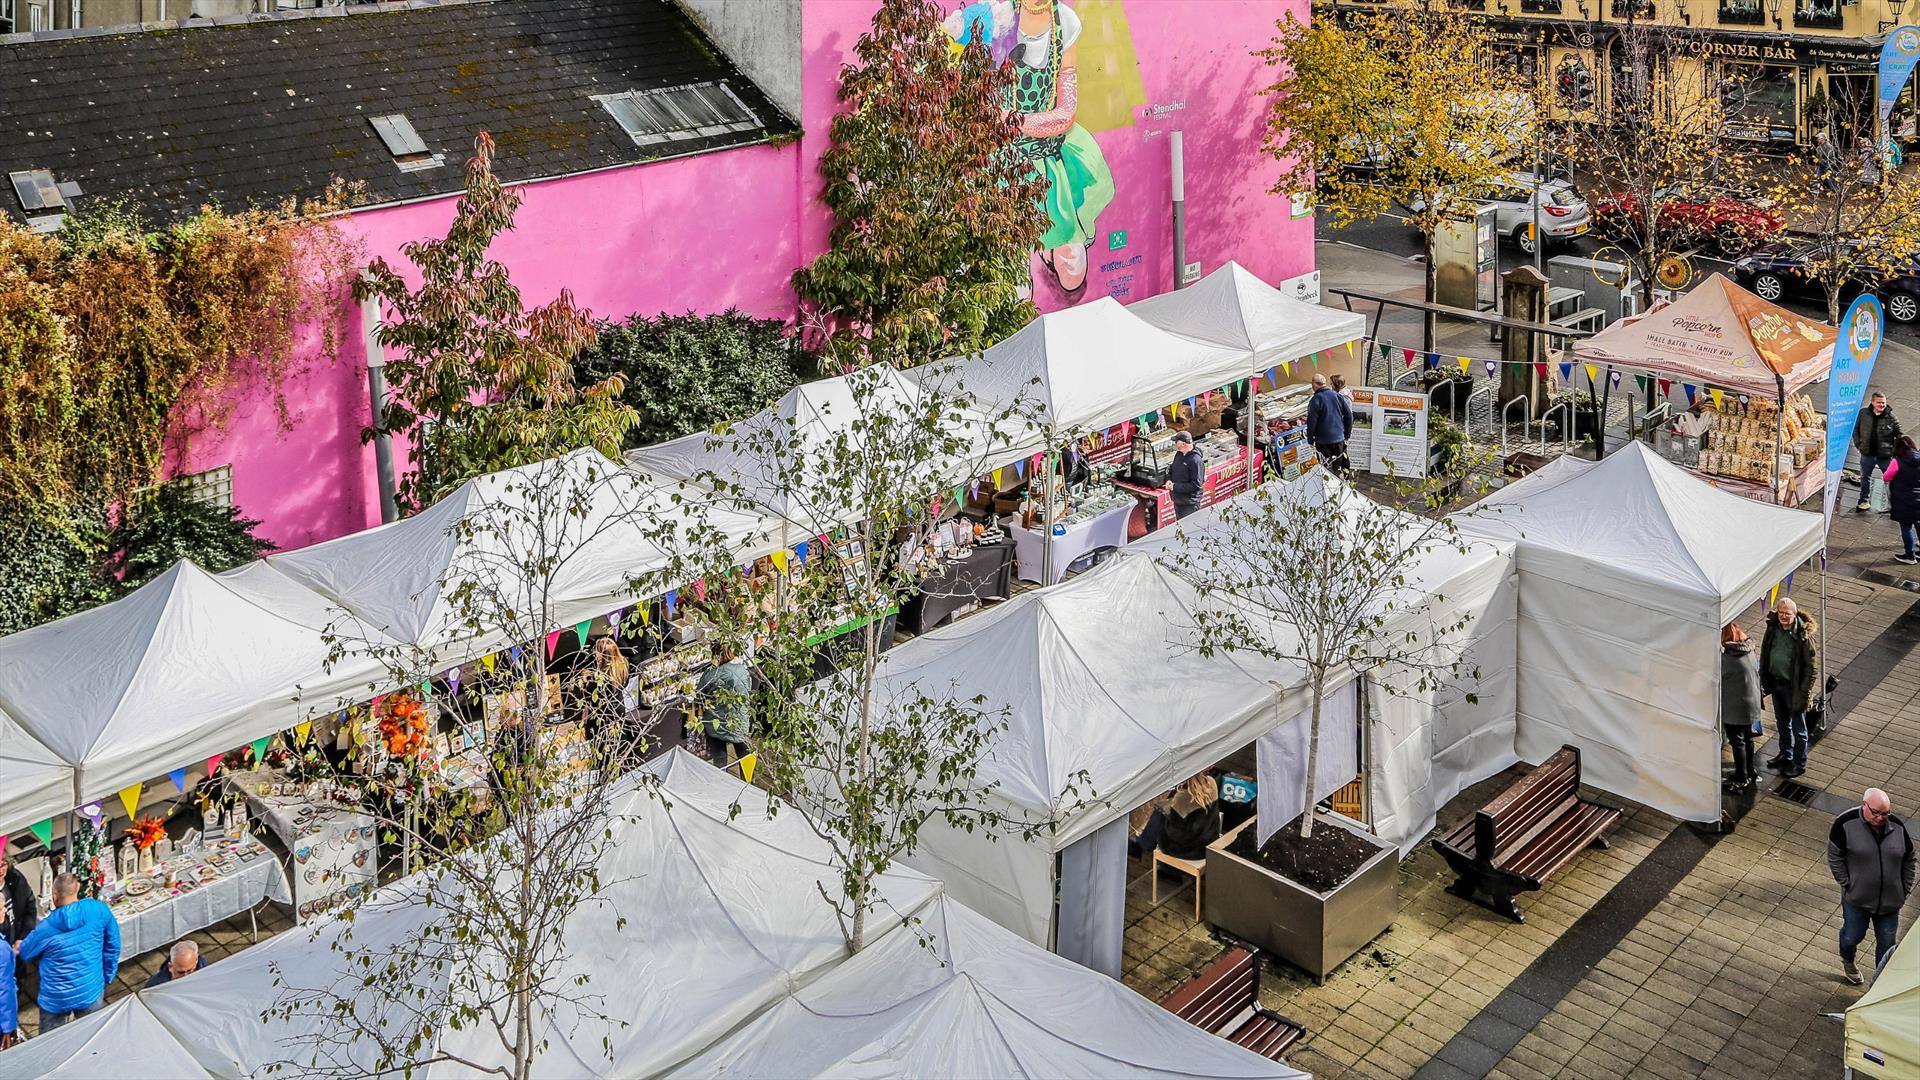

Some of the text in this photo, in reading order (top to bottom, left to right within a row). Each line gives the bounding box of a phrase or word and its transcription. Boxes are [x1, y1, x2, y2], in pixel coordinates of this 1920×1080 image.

[1690, 42, 1759, 57] CORNER
[1763, 46, 1797, 60] BAR
[1153, 97, 1186, 115] Stendhal
[1672, 317, 1722, 333] Popcorn
[1646, 334, 1665, 344] SMALL
[1667, 340, 1688, 348] BATCH
[1695, 344, 1718, 354] FAMILY
[1836, 358, 1851, 369] ART
[1383, 395, 1400, 403] TULLY
[1839, 384, 1862, 398] CRAFT
